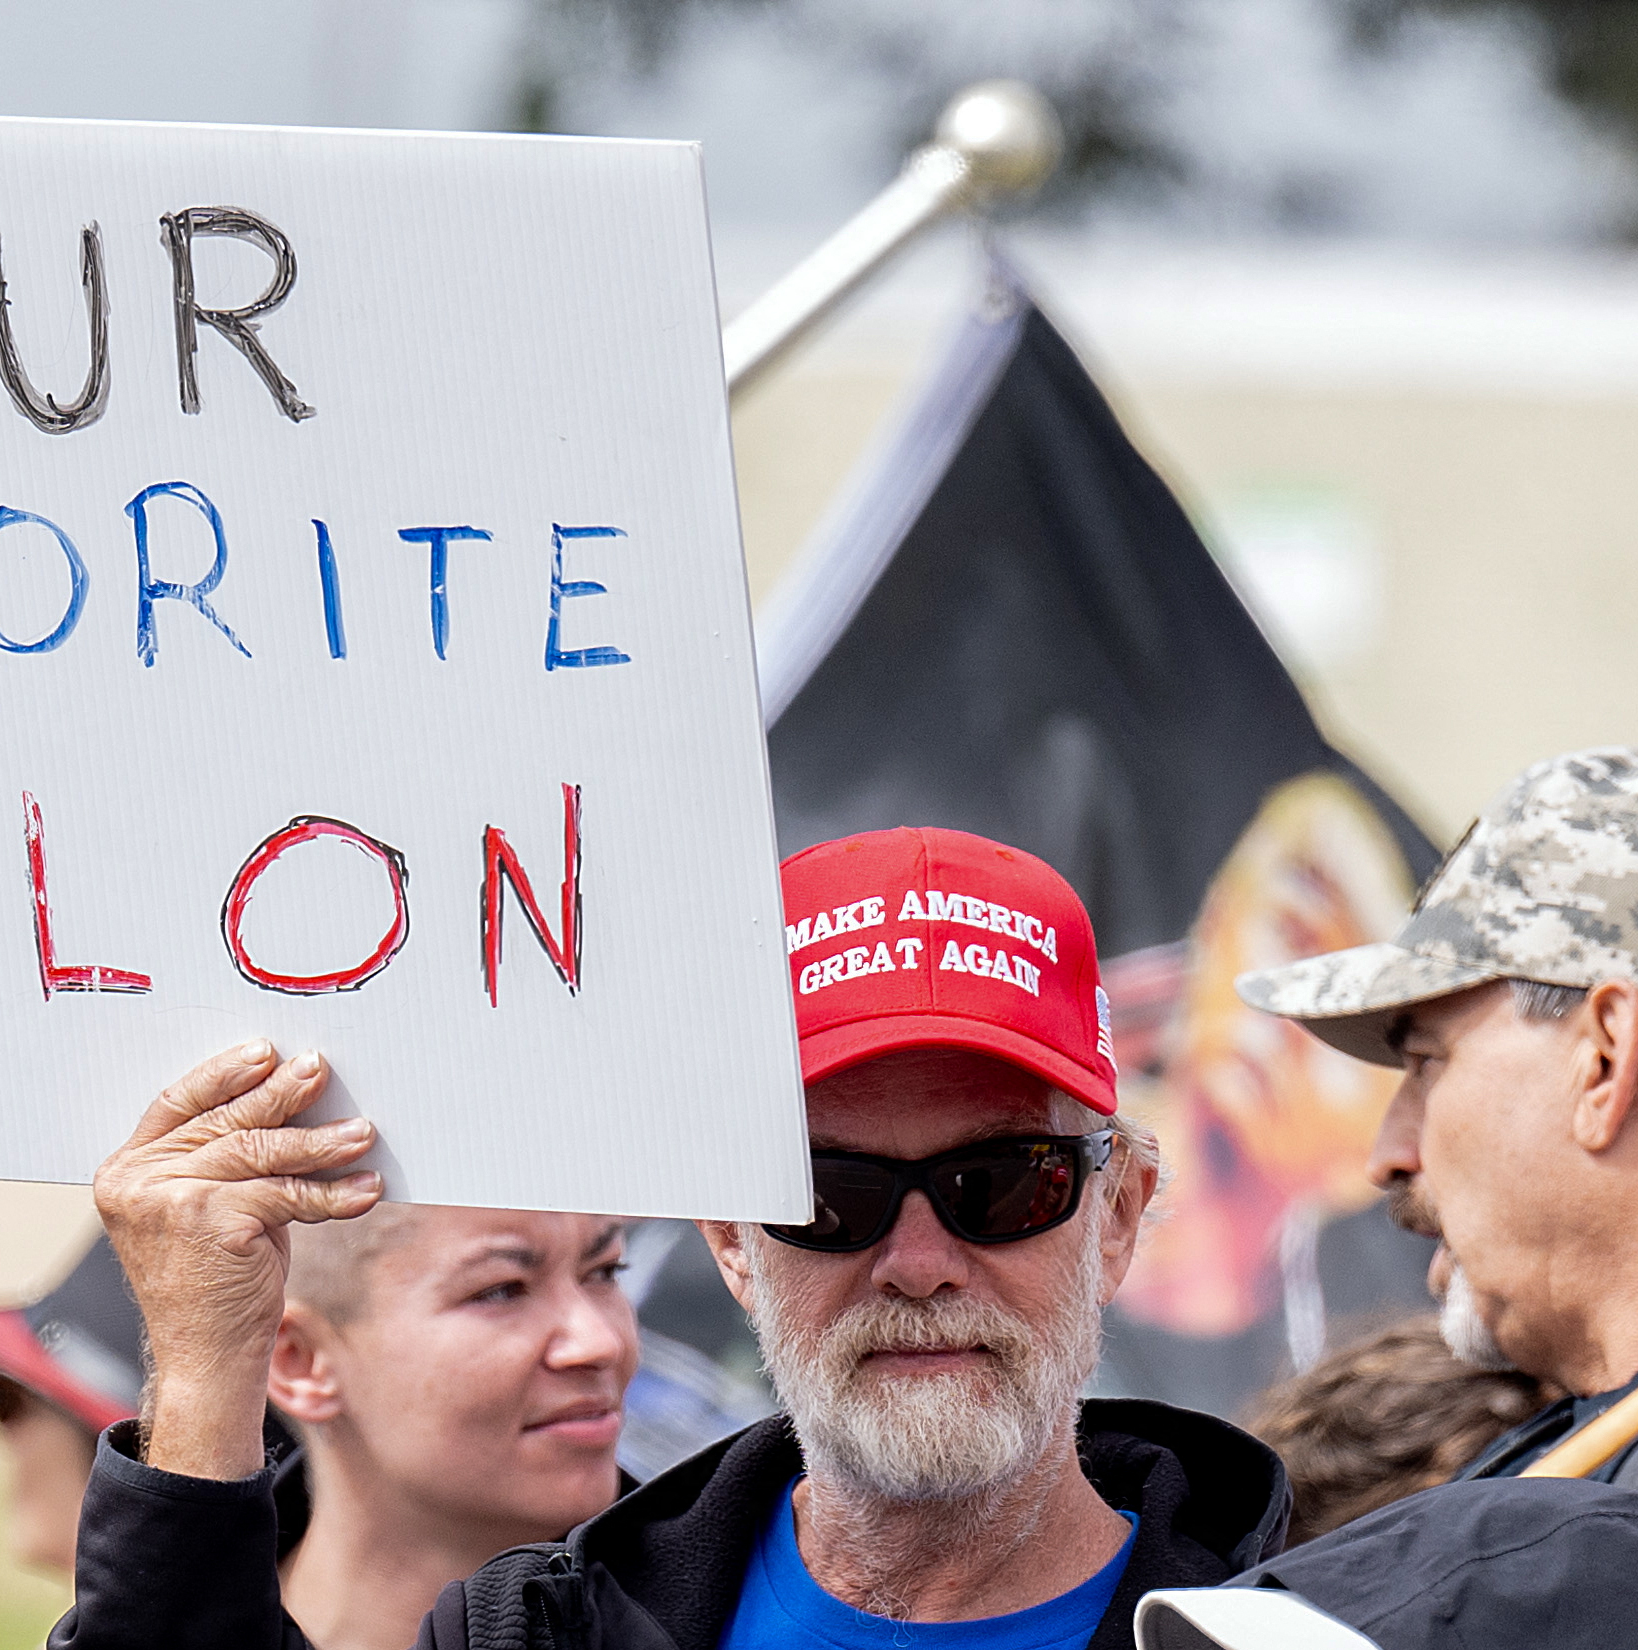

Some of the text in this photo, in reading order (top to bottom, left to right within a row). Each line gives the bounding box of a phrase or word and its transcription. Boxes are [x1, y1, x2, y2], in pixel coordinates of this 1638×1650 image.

[785, 890, 1059, 966] MAKE AMERICA
[799, 937, 1041, 998] GREAT AGAIN
